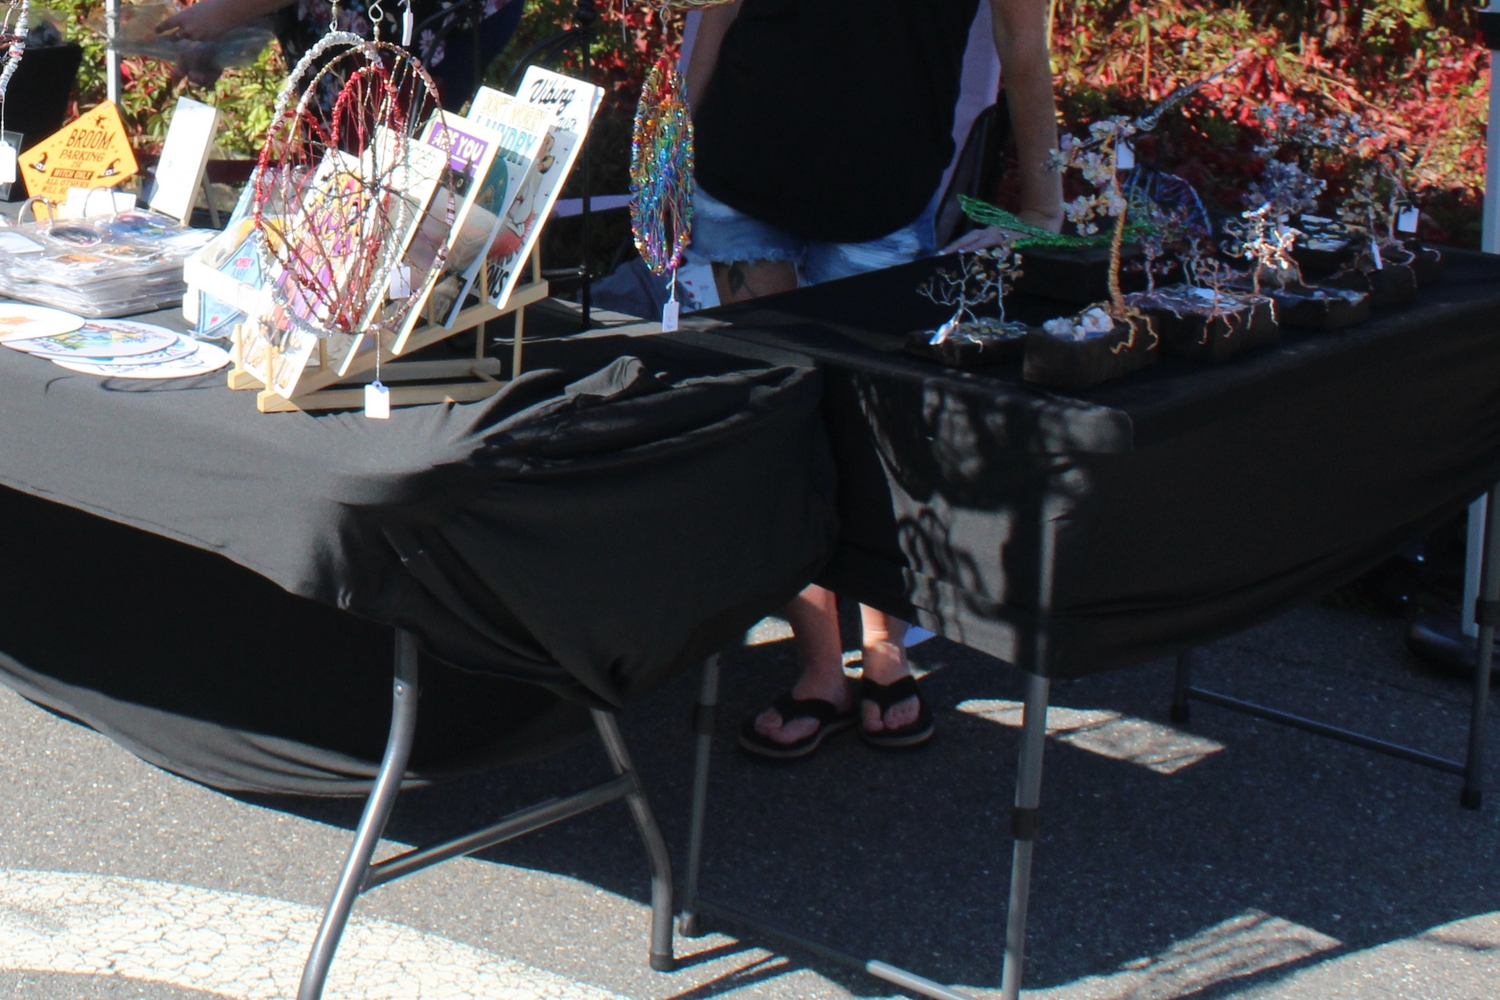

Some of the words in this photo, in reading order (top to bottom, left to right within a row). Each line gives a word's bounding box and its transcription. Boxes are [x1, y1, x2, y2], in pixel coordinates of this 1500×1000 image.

[529, 78, 576, 116] Vibing
[65, 128, 117, 150] BROOM
[456, 134, 485, 162] YOU
[58, 149, 106, 162] PARKING
[53, 169, 73, 178] WITCH
[74, 170, 93, 180] ONLY
[41, 185, 57, 194] WILL
[45, 178, 60, 186] ALL
[62, 179, 91, 188] OTHERS
